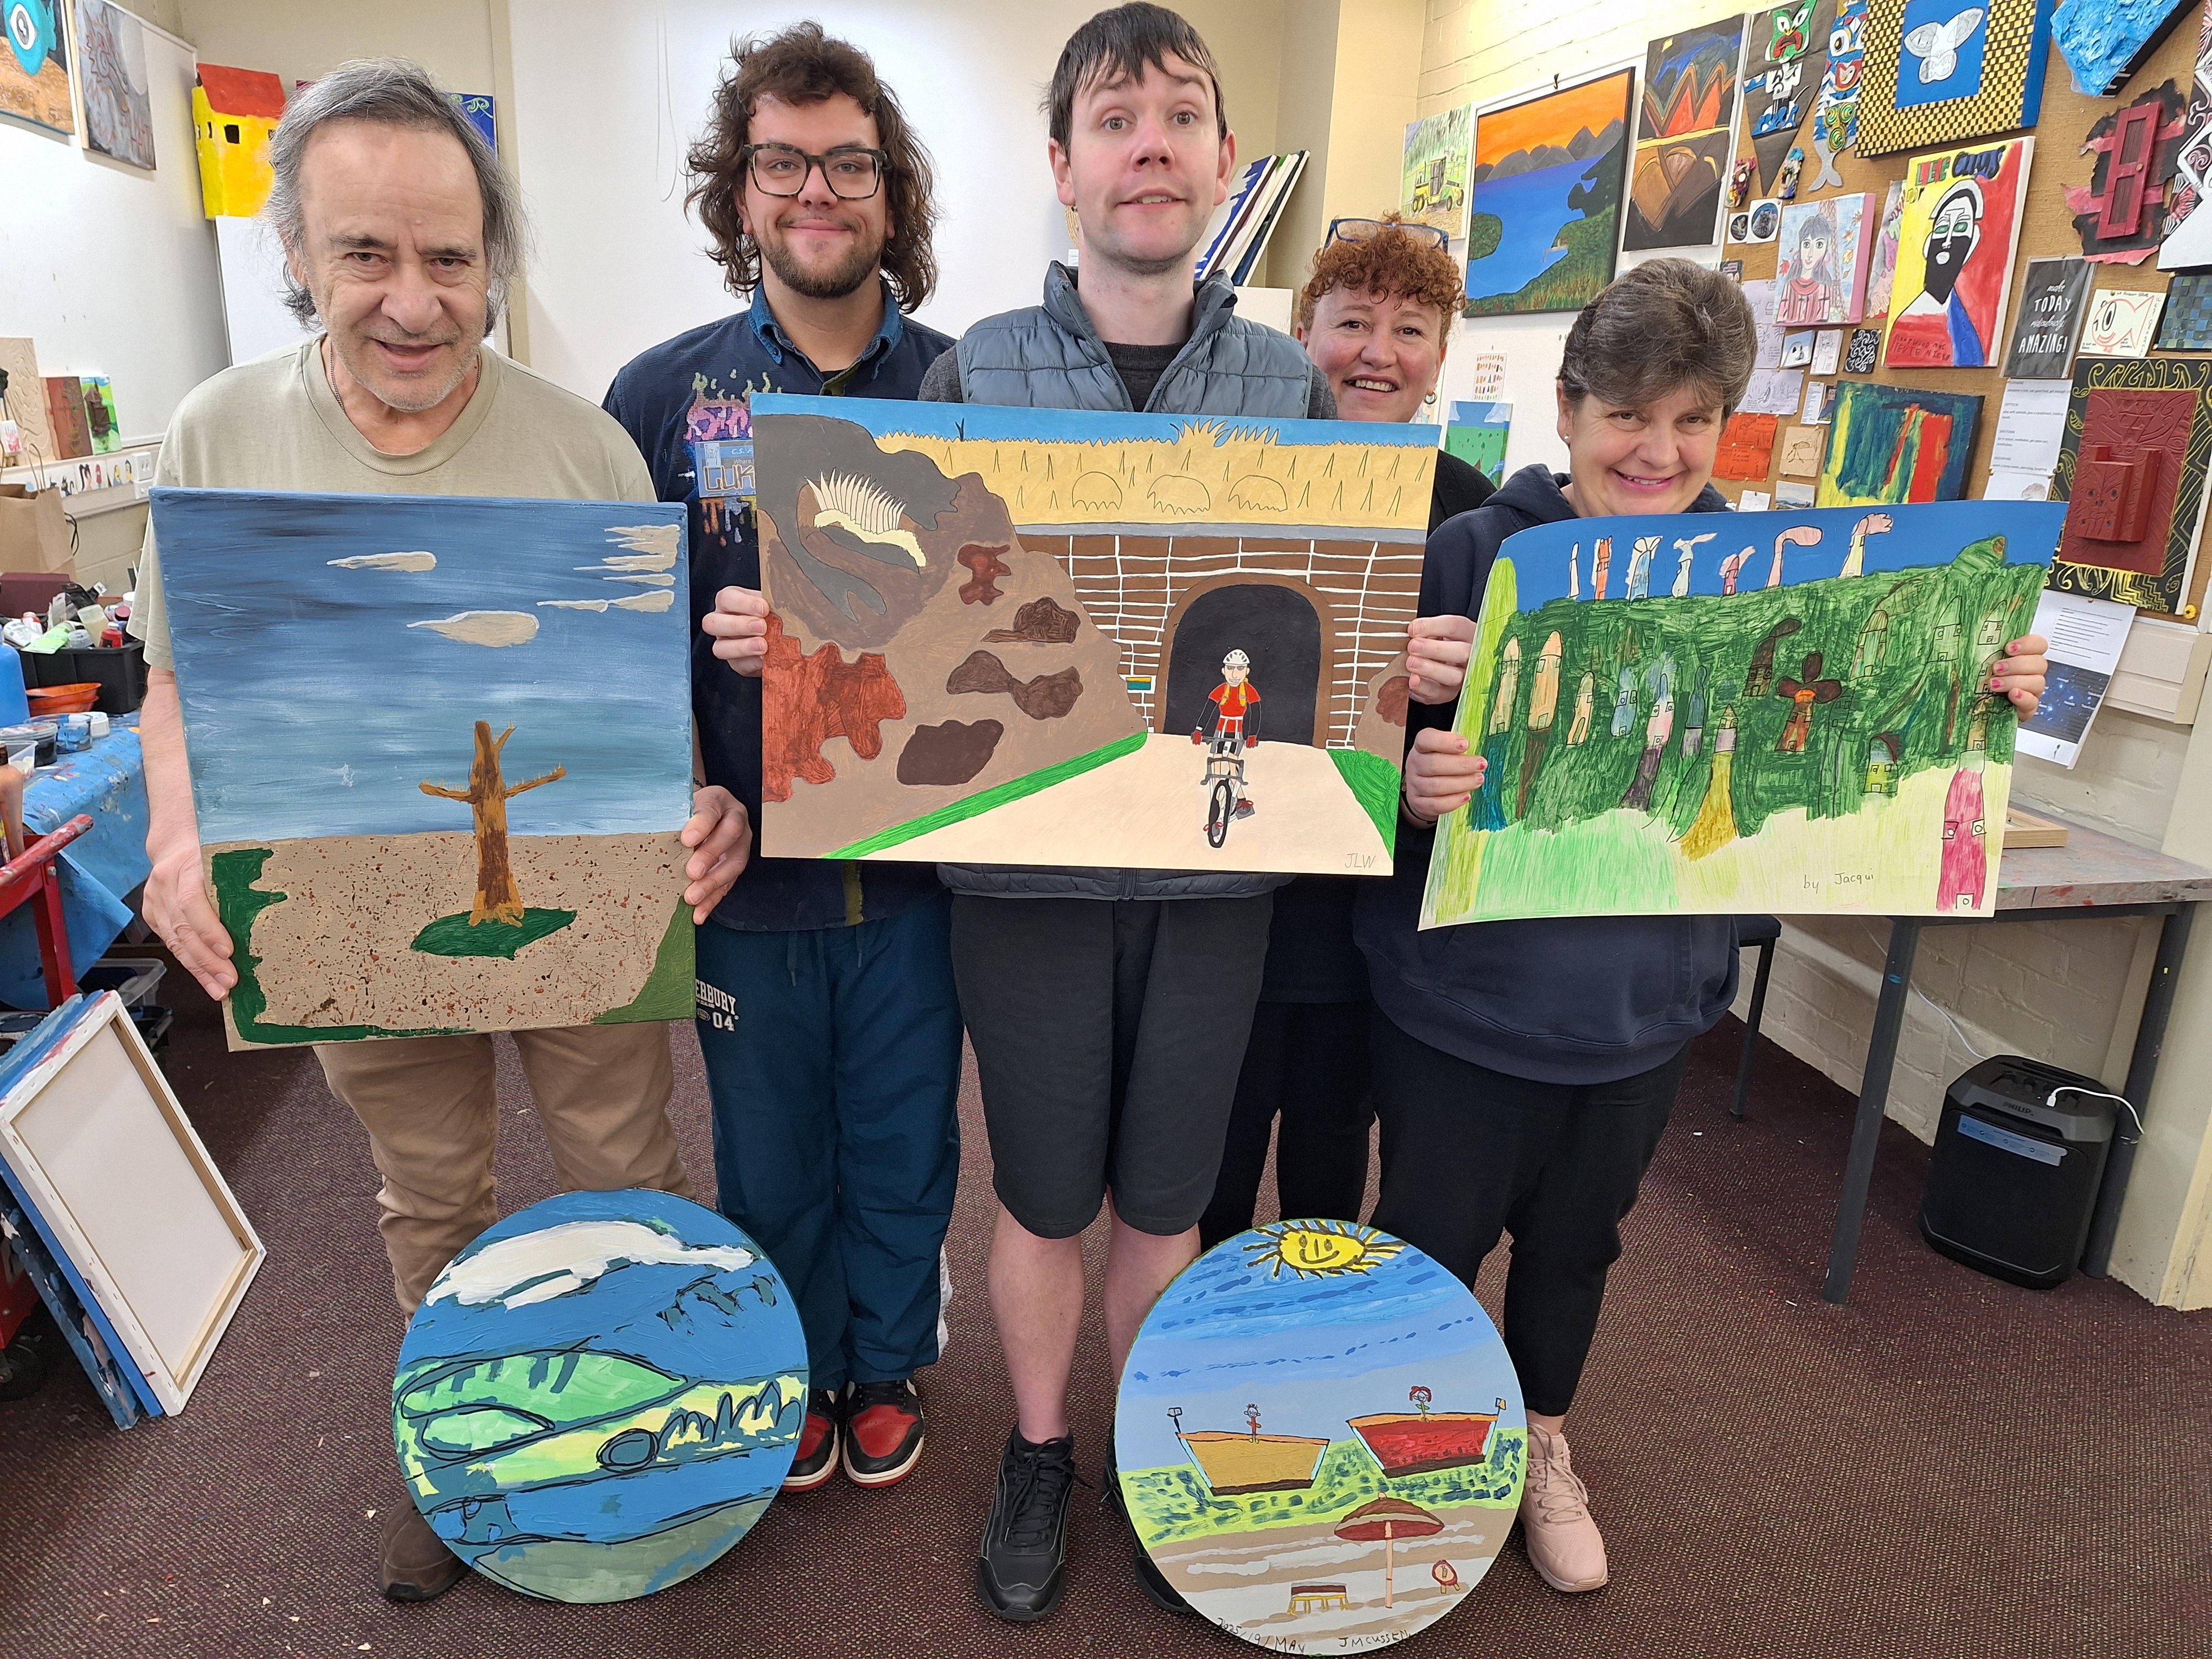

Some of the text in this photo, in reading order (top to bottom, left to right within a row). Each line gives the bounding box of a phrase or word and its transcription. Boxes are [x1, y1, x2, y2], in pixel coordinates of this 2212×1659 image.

[2047, 279, 2066, 292] make
[2034, 295, 2072, 312] TODAY
[2018, 333, 2068, 353] AMAZING!
[1345, 853, 1376, 868] JLW
[1803, 868, 1874, 894] by Jacqui
[712, 1012, 735, 1032] 04
